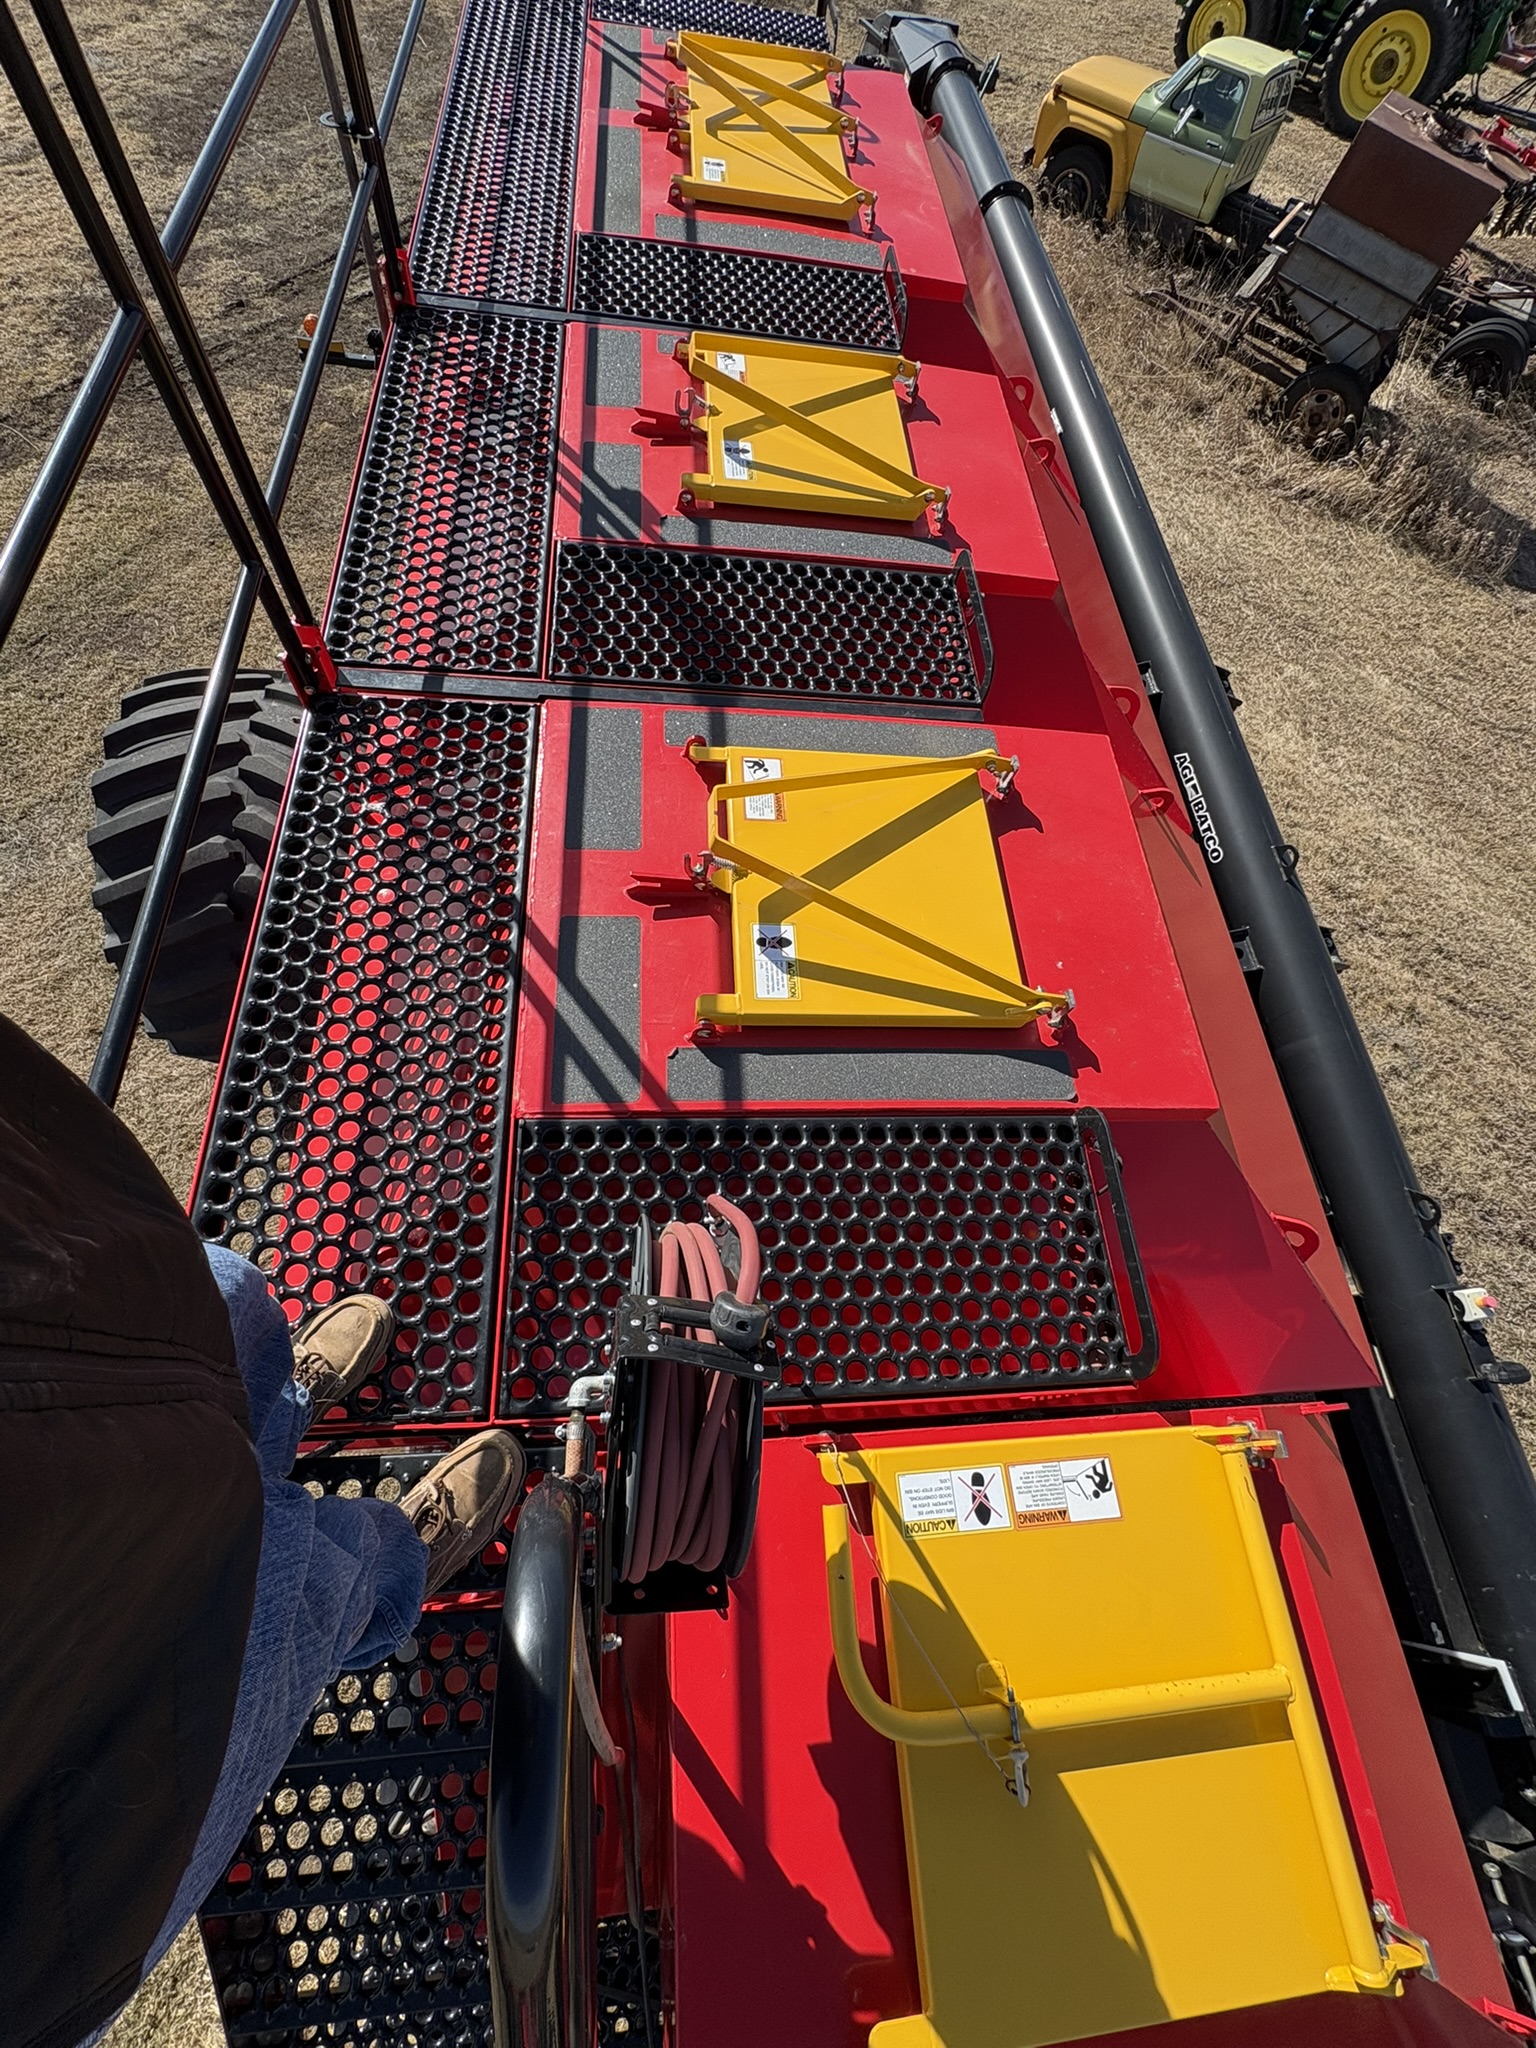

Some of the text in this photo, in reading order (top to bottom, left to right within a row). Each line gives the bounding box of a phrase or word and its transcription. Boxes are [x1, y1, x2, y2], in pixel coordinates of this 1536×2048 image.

[1174, 753, 1223, 863] AGI BATCO
[788, 970, 797, 998] CAUTION
[905, 1520, 946, 1535] CAUTION
[1018, 1511, 1059, 1524] WARNING
